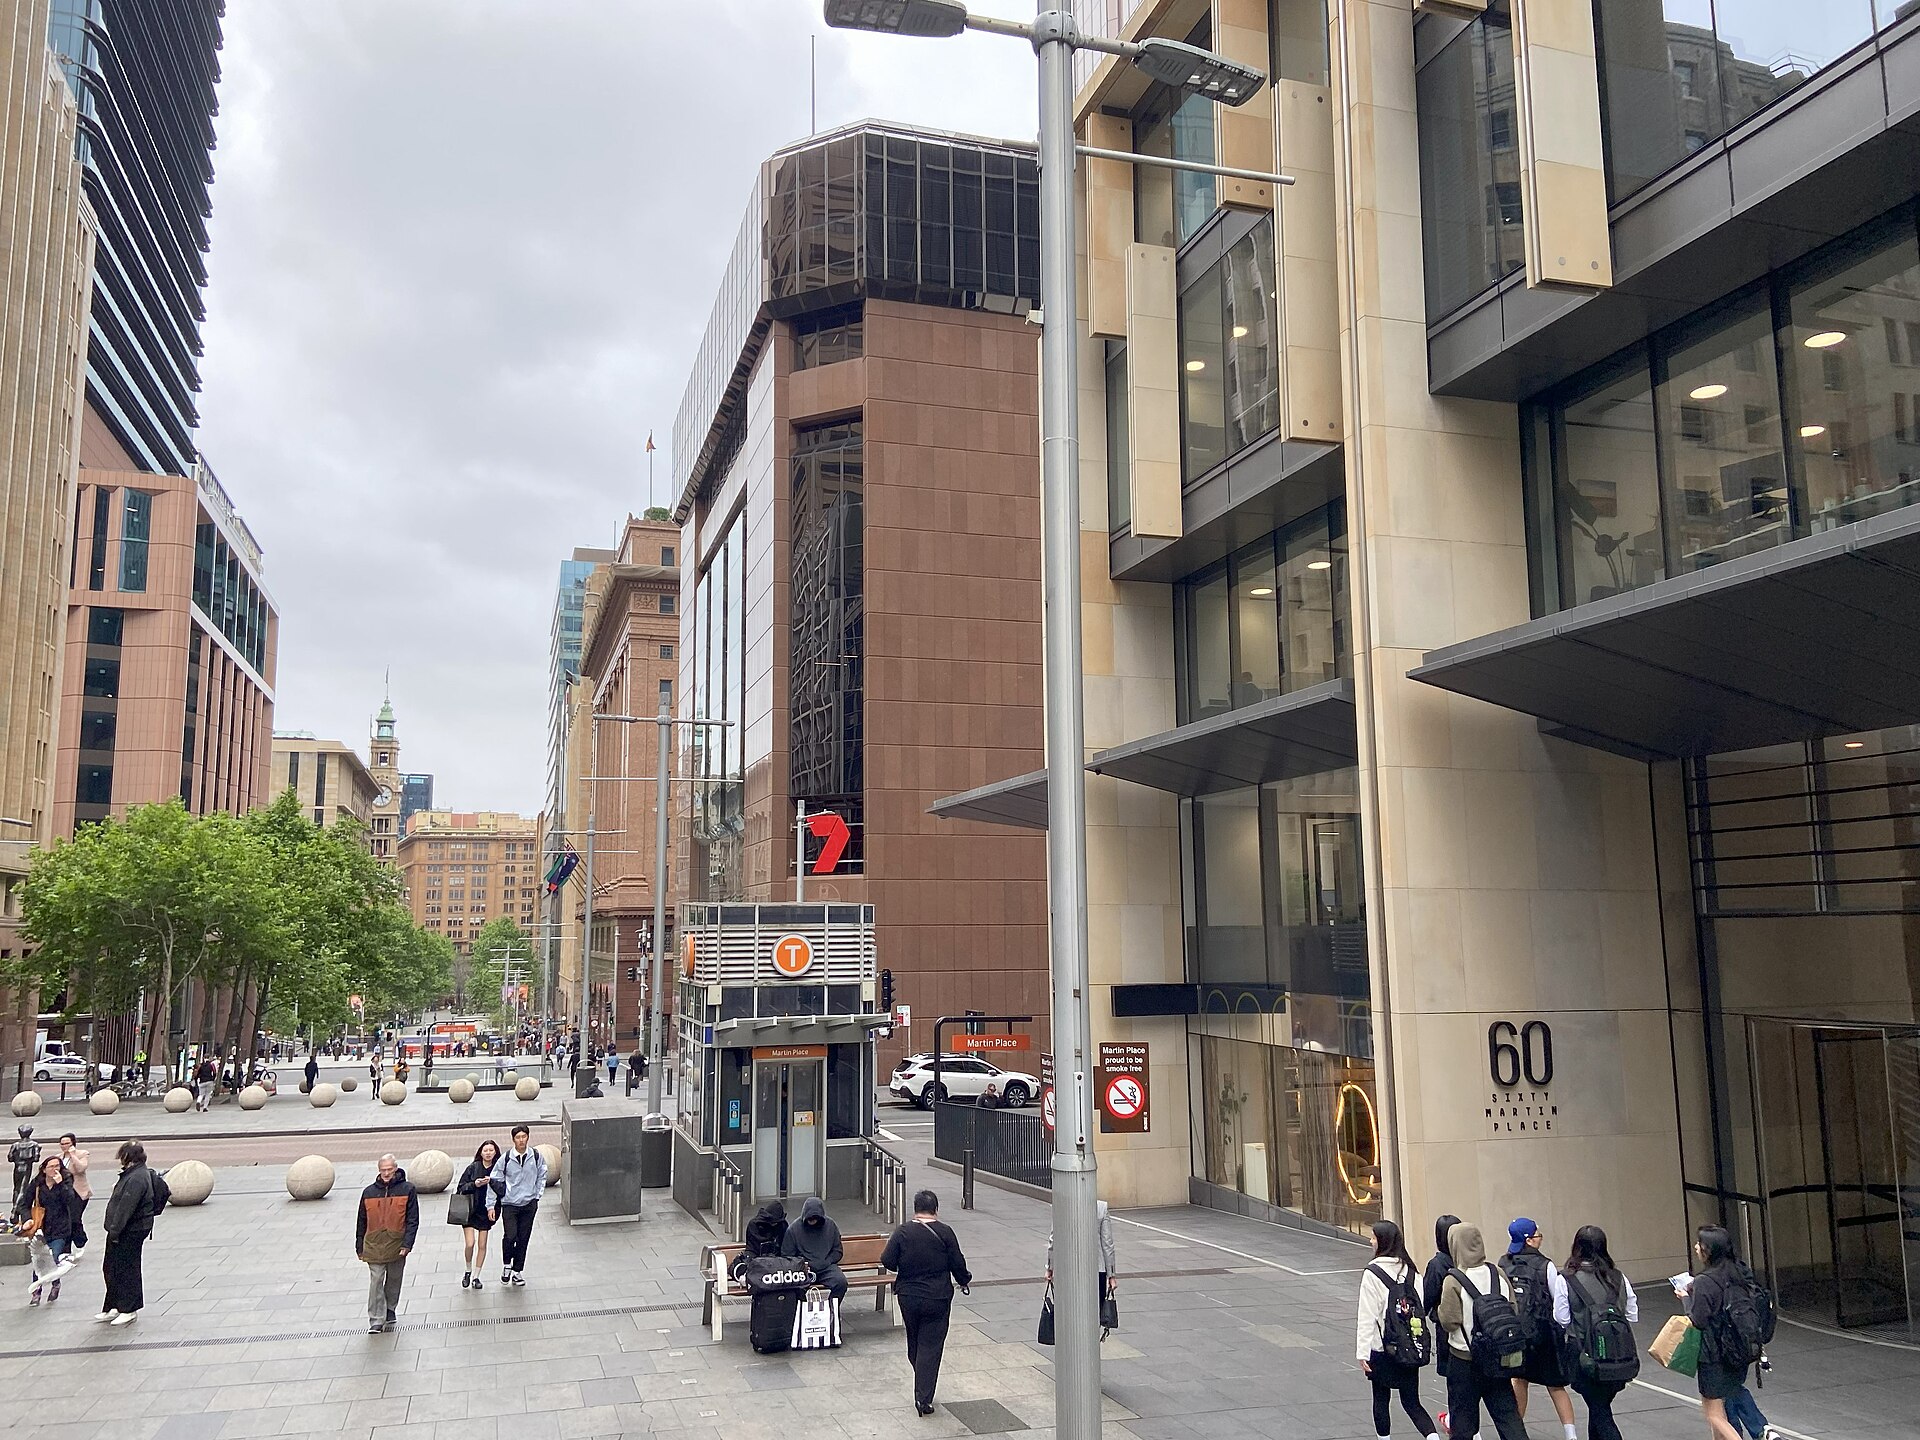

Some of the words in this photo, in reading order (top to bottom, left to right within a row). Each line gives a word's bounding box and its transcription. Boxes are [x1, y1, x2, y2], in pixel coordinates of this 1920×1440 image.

[784, 944, 802, 968] T
[967, 1038, 994, 1048] Martin
[995, 1038, 1017, 1047] Place
[792, 1048, 809, 1056] Place
[1102, 1046, 1125, 1054] Martin
[1126, 1046, 1146, 1054] Place
[1488, 1020, 1554, 1086] 60
[1105, 1056, 1125, 1065] proud
[1126, 1056, 1133, 1064] to
[1134, 1056, 1143, 1064] be
[1491, 1092, 1549, 1103] SIXTY
[1485, 1105, 1558, 1118] MARTIN
[1493, 1120, 1552, 1132] PLACE
[762, 1270, 806, 1284] adidas
